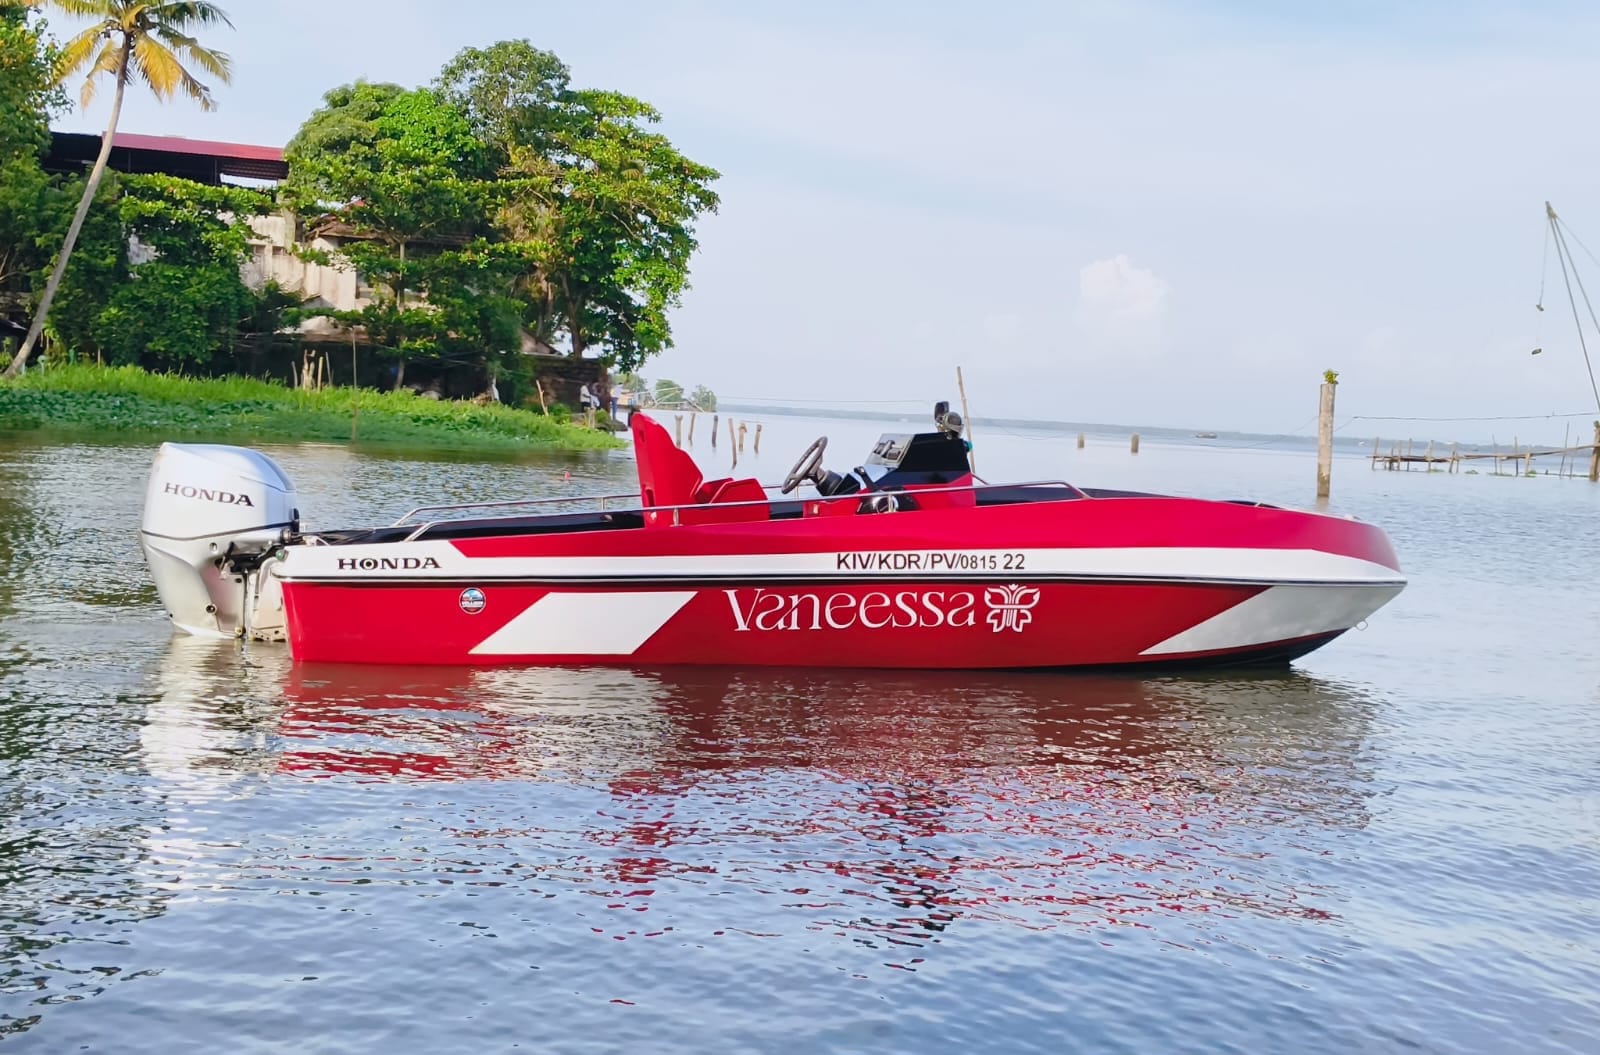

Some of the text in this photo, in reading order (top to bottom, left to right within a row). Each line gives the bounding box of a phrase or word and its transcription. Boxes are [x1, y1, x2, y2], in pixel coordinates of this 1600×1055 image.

[164, 482, 254, 507] HONDA
[338, 556, 441, 570] HONDA
[1003, 553, 1025, 570] 22
[722, 587, 977, 632] Vaneessa
